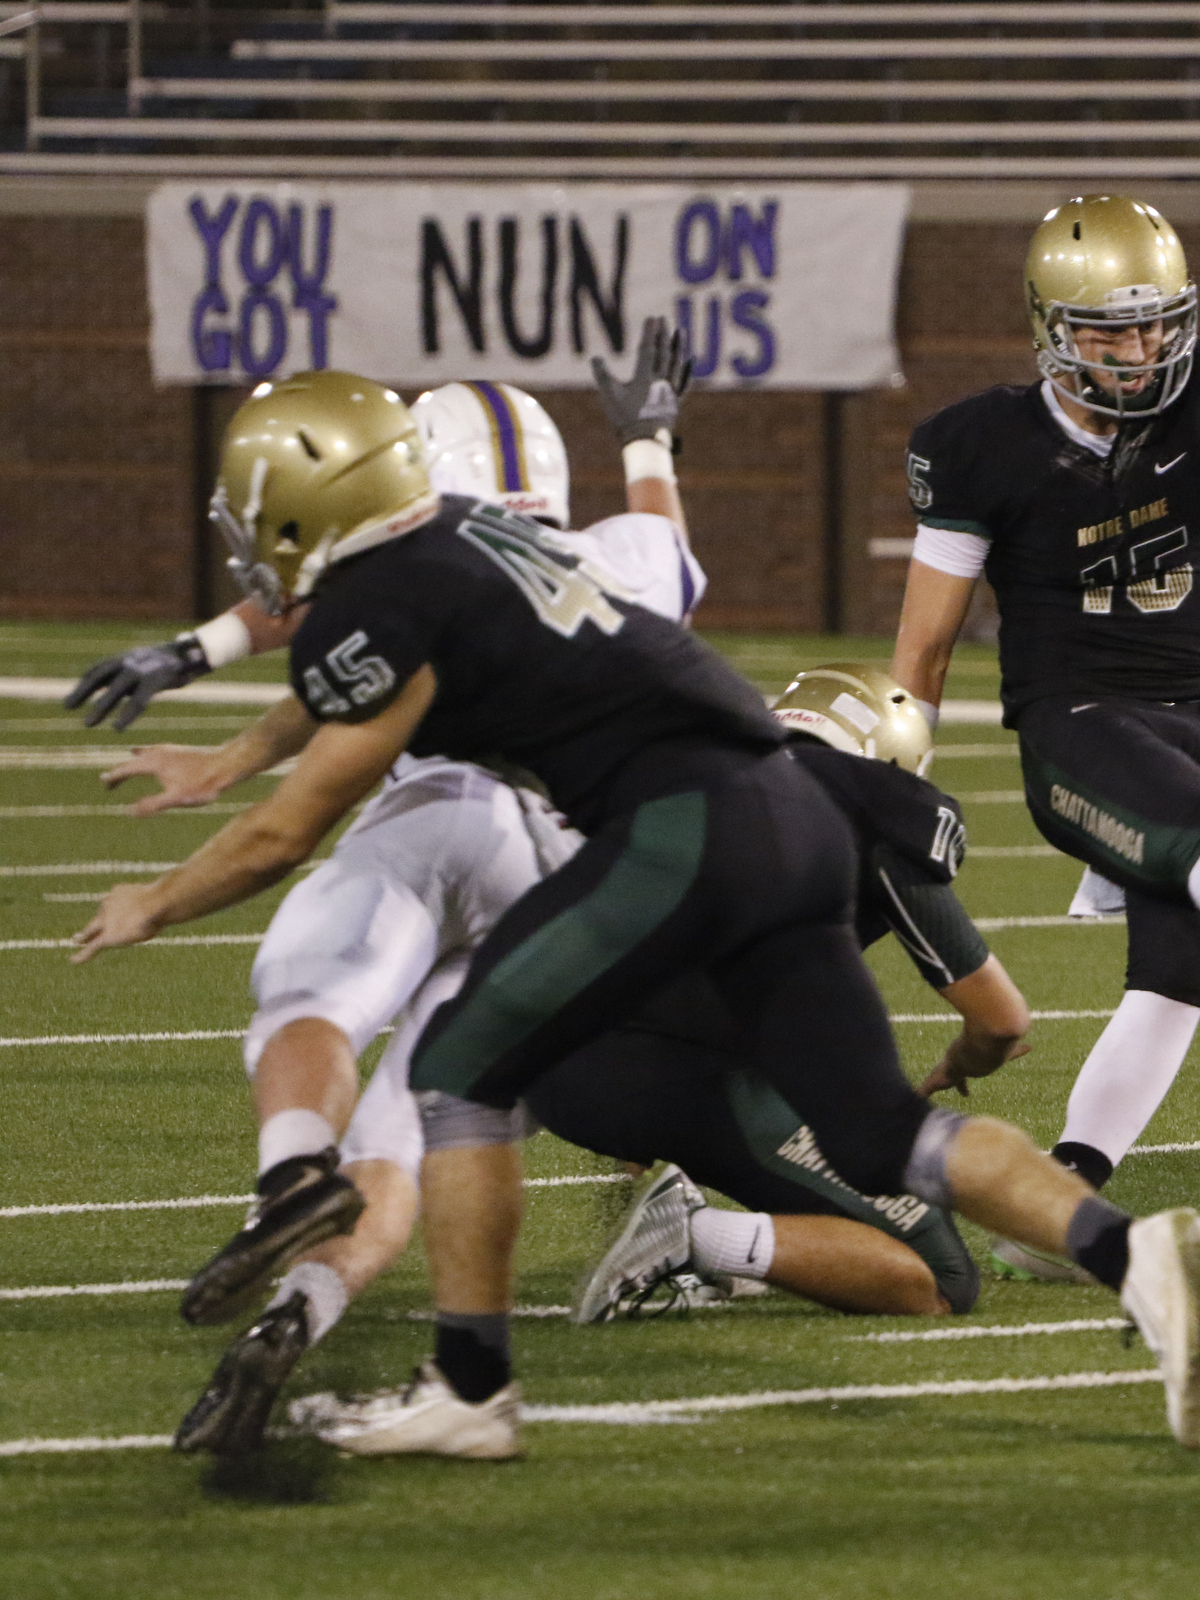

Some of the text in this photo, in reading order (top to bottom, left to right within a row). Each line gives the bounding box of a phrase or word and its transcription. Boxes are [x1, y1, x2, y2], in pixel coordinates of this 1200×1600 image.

[189, 196, 332, 292] YOU
[422, 211, 630, 359] NUN
[674, 200, 778, 284] ON
[191, 290, 338, 377] GOT
[676, 292, 776, 377] US
[1077, 497, 1169, 547] NOTRE DAME
[1080, 526, 1194, 614] 15
[303, 630, 397, 713] 45
